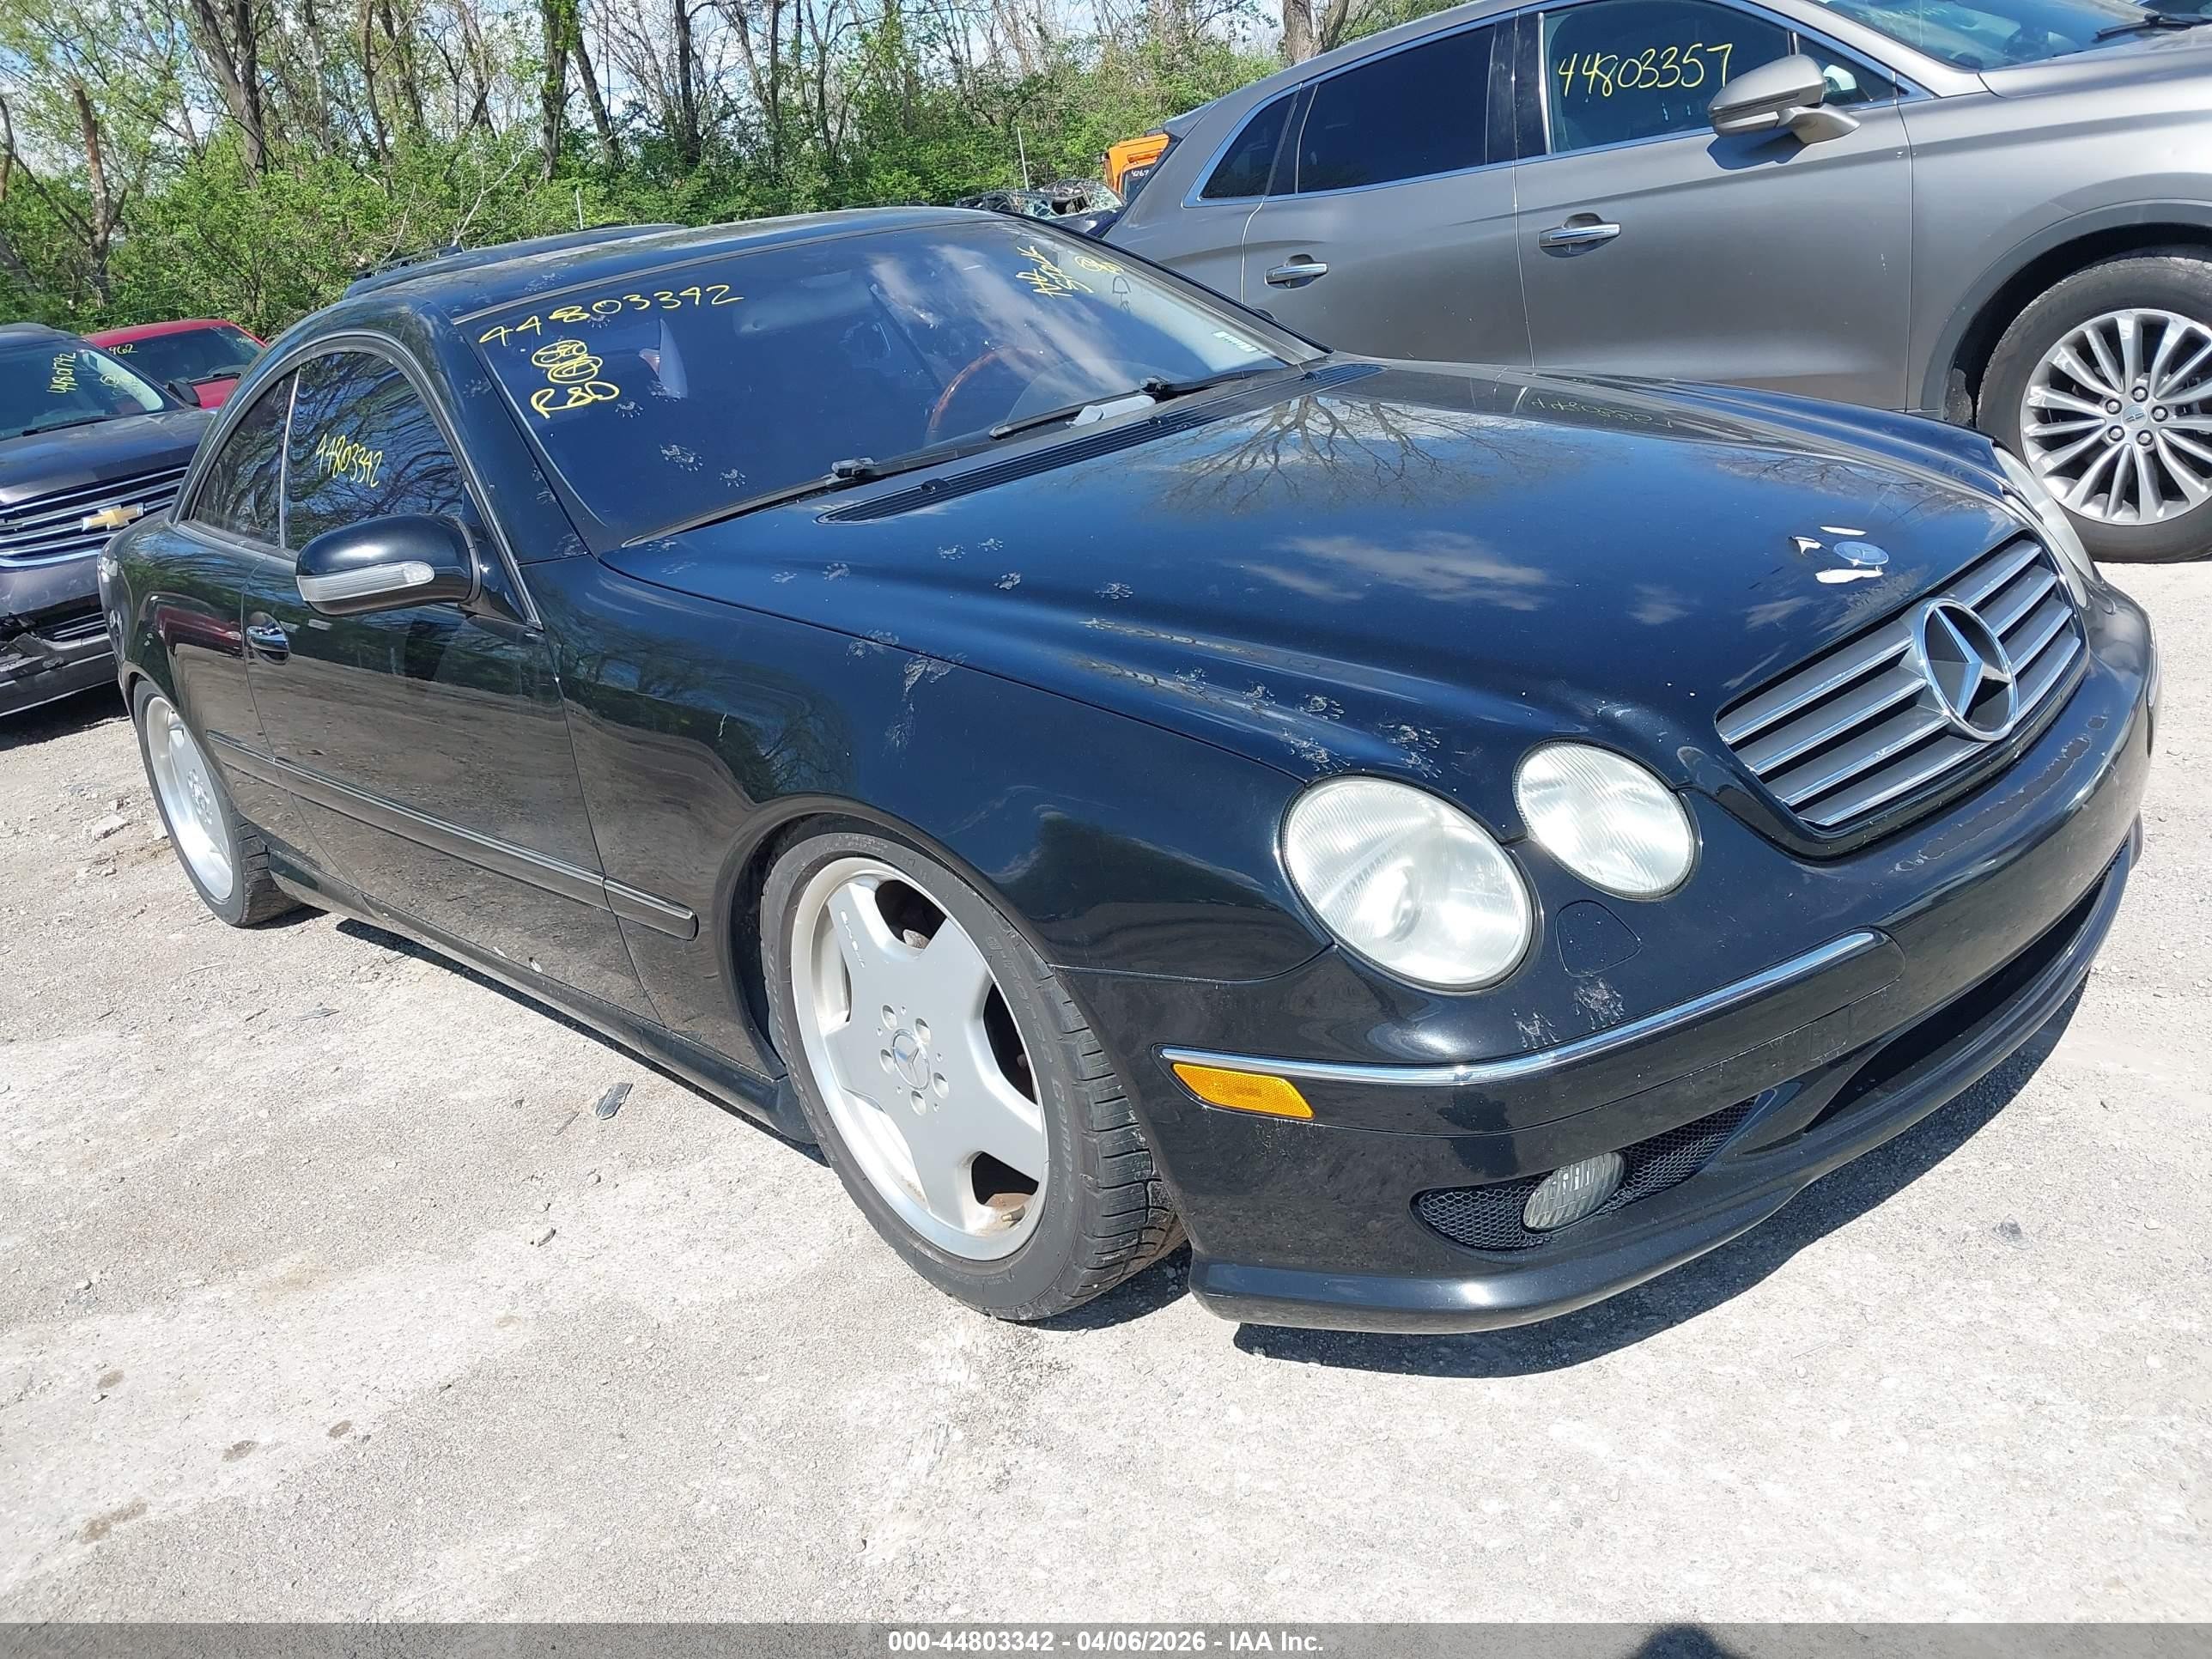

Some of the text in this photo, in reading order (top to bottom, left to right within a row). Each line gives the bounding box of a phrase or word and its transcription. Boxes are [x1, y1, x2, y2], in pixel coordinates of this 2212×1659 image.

[1559, 43, 1733, 97] 44803357
[479, 284, 744, 346] 44803342
[316, 433, 383, 488] 44803342
